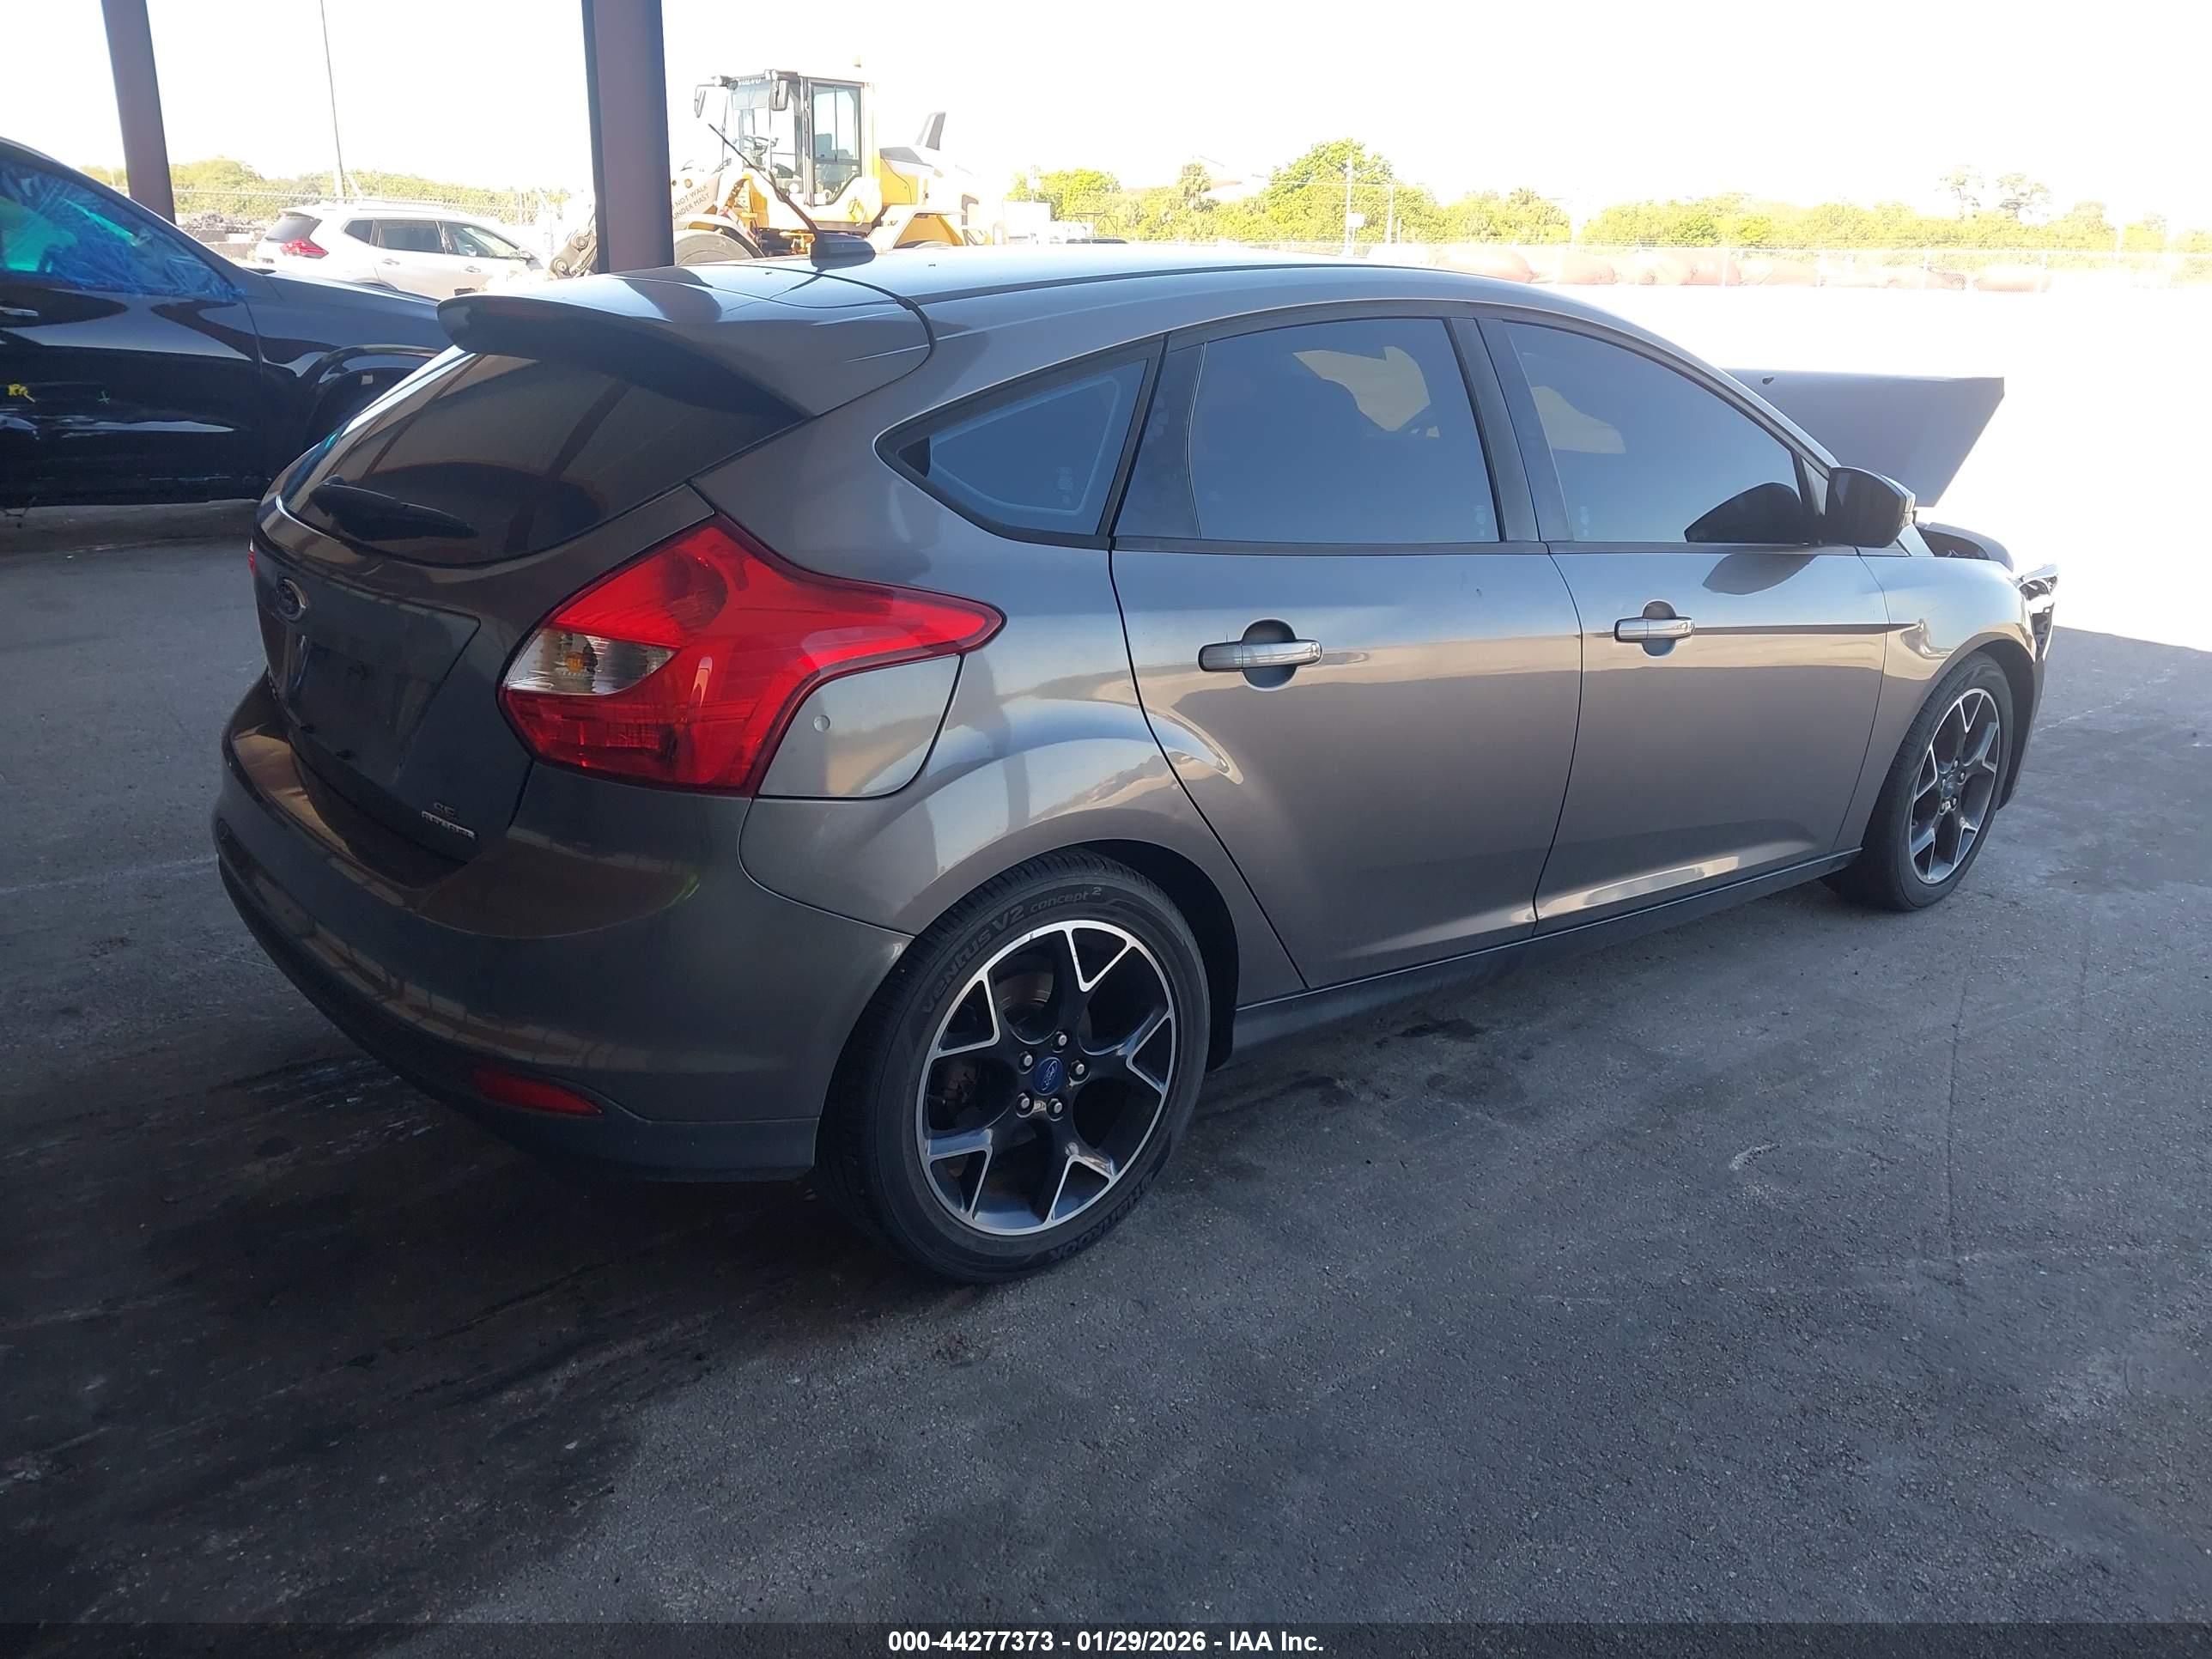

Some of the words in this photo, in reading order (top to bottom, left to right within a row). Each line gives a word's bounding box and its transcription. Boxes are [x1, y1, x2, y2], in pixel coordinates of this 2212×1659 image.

[672, 204, 694, 220] UNDER
[693, 192, 710, 207] MAST
[674, 195, 689, 208] NOT
[690, 184, 708, 198] WALK
[992, 905, 1024, 931] V2
[1030, 890, 1090, 913] concept
